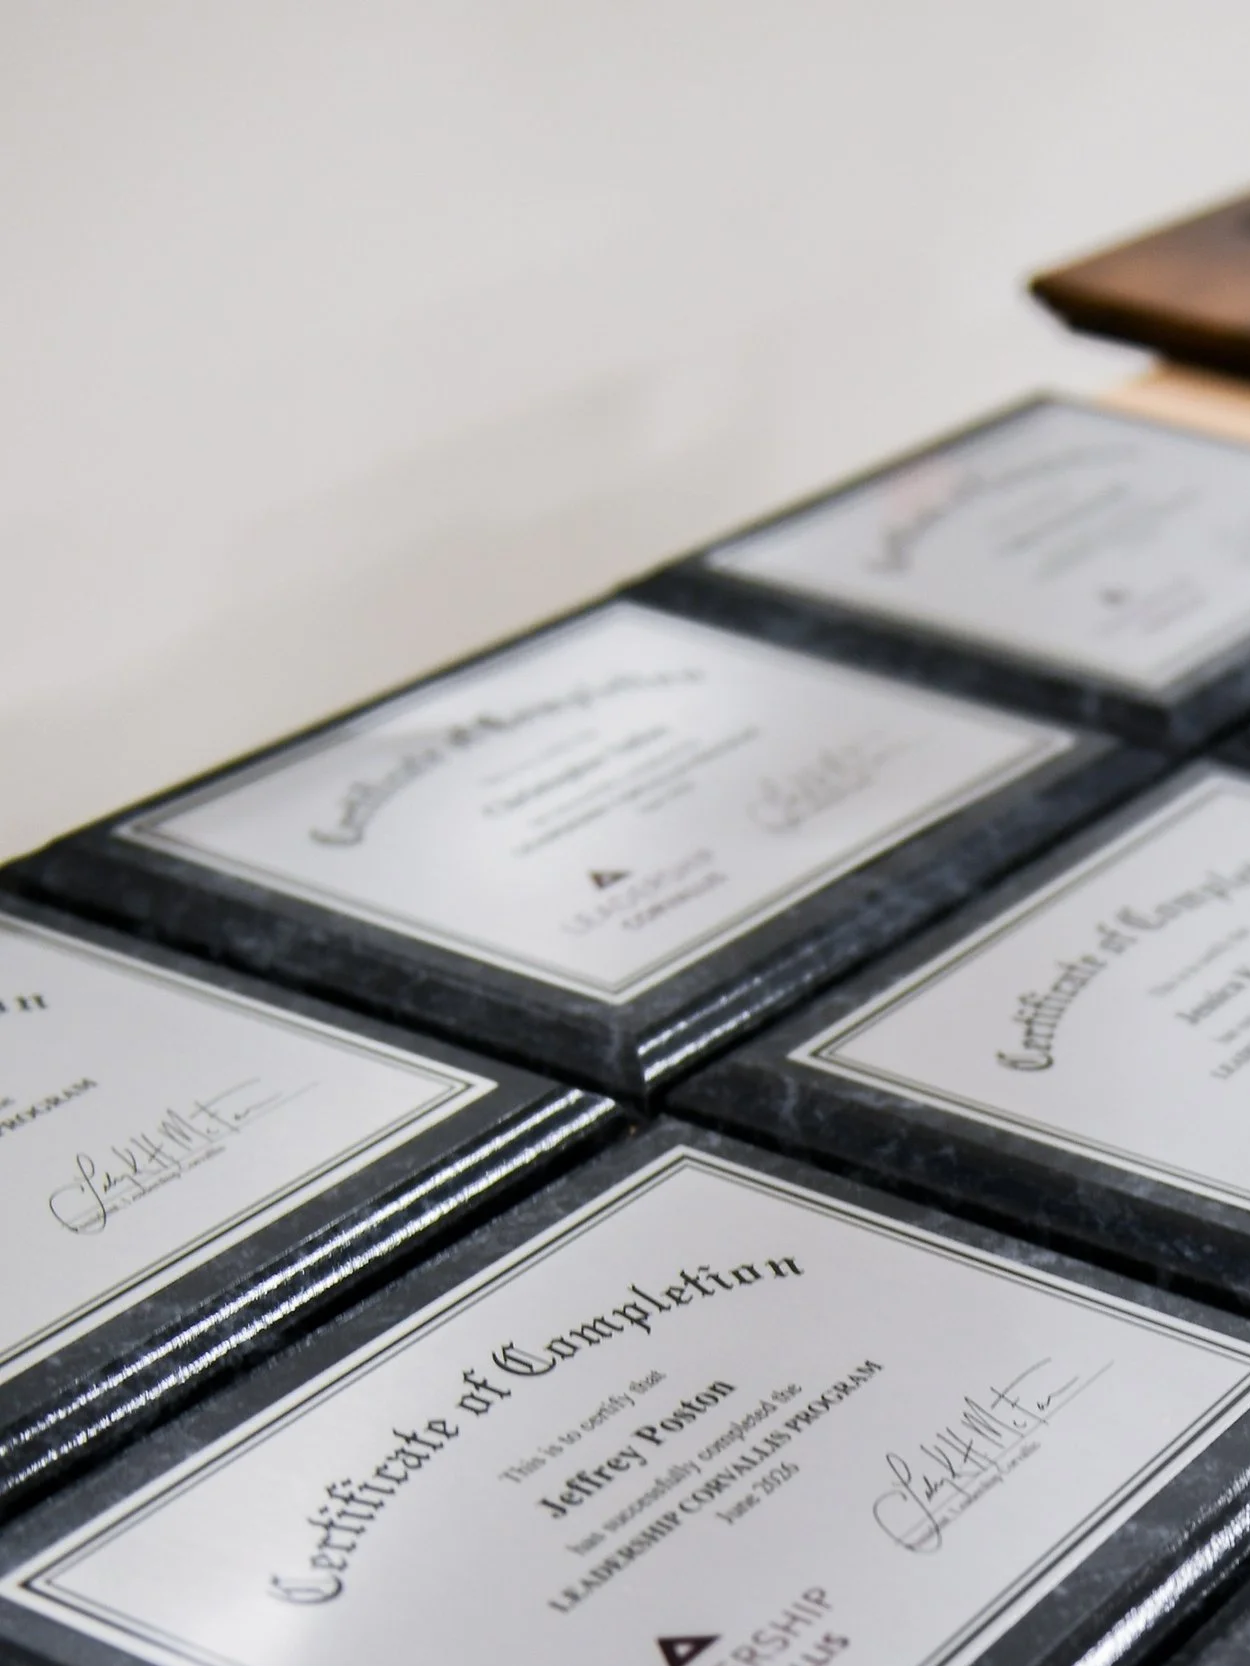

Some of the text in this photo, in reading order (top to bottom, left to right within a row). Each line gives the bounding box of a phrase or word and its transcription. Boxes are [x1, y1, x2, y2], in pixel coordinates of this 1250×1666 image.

[268, 1253, 806, 1606] Certificate of Completion
[499, 1456, 548, 1485] This
[559, 1431, 583, 1450] to
[580, 1394, 636, 1433] certify
[629, 1368, 669, 1396] that
[537, 1379, 738, 1521] Jeffrey Poston
[546, 1507, 683, 1615] LEADERSHIP
[678, 1429, 793, 1516] CORVALLIS
[784, 1358, 884, 1434] PROGRAM
[602, 1460, 701, 1534] successfully
[696, 1396, 778, 1463] completed
[770, 1380, 804, 1404] the
[715, 1493, 762, 1526] June
